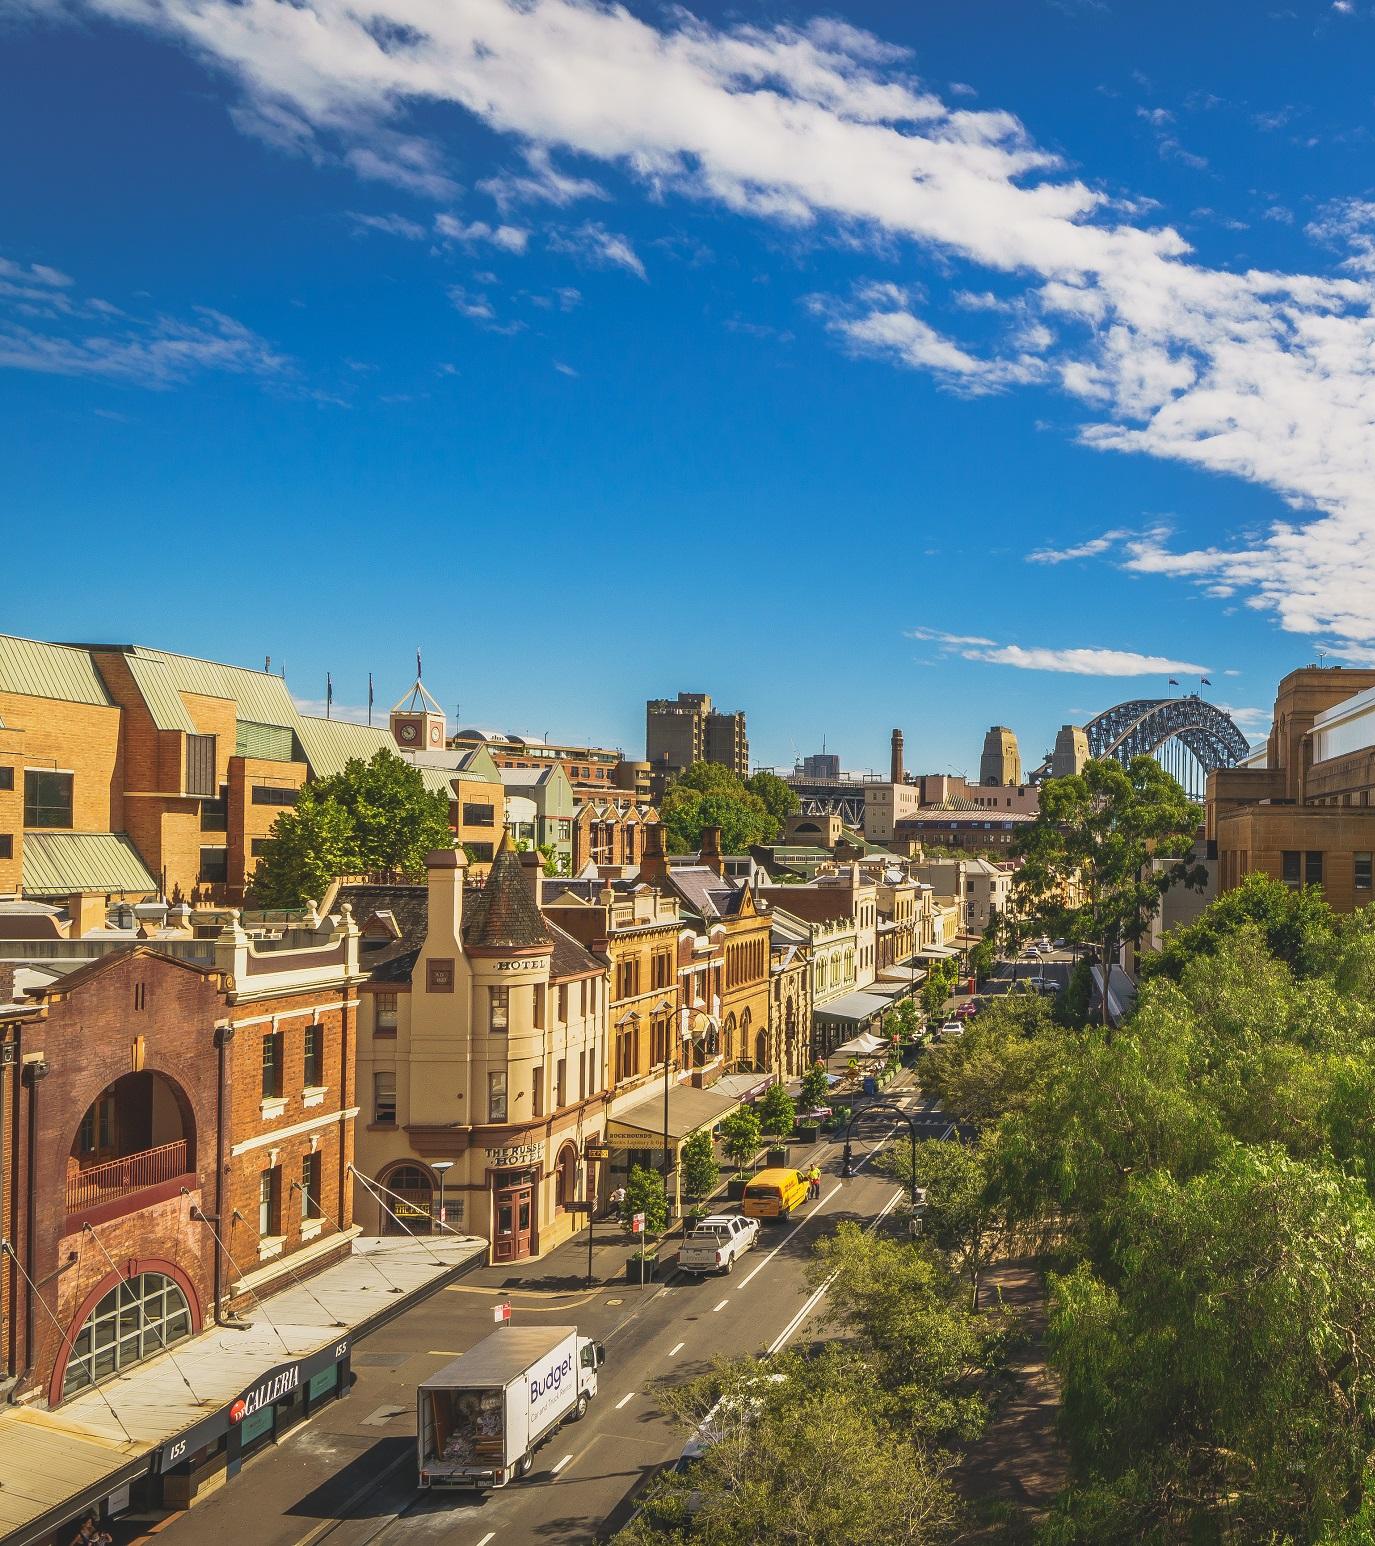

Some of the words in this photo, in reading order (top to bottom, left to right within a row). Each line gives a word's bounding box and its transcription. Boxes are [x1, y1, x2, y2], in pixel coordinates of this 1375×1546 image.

[496, 960, 546, 971] HOTEL
[485, 1148, 509, 1158] THE
[494, 1150, 542, 1167] HOTEL
[335, 1341, 347, 1358] 155
[530, 1352, 572, 1404] Budget
[245, 1365, 299, 1416] GALLERIA
[170, 1440, 186, 1460] 155
